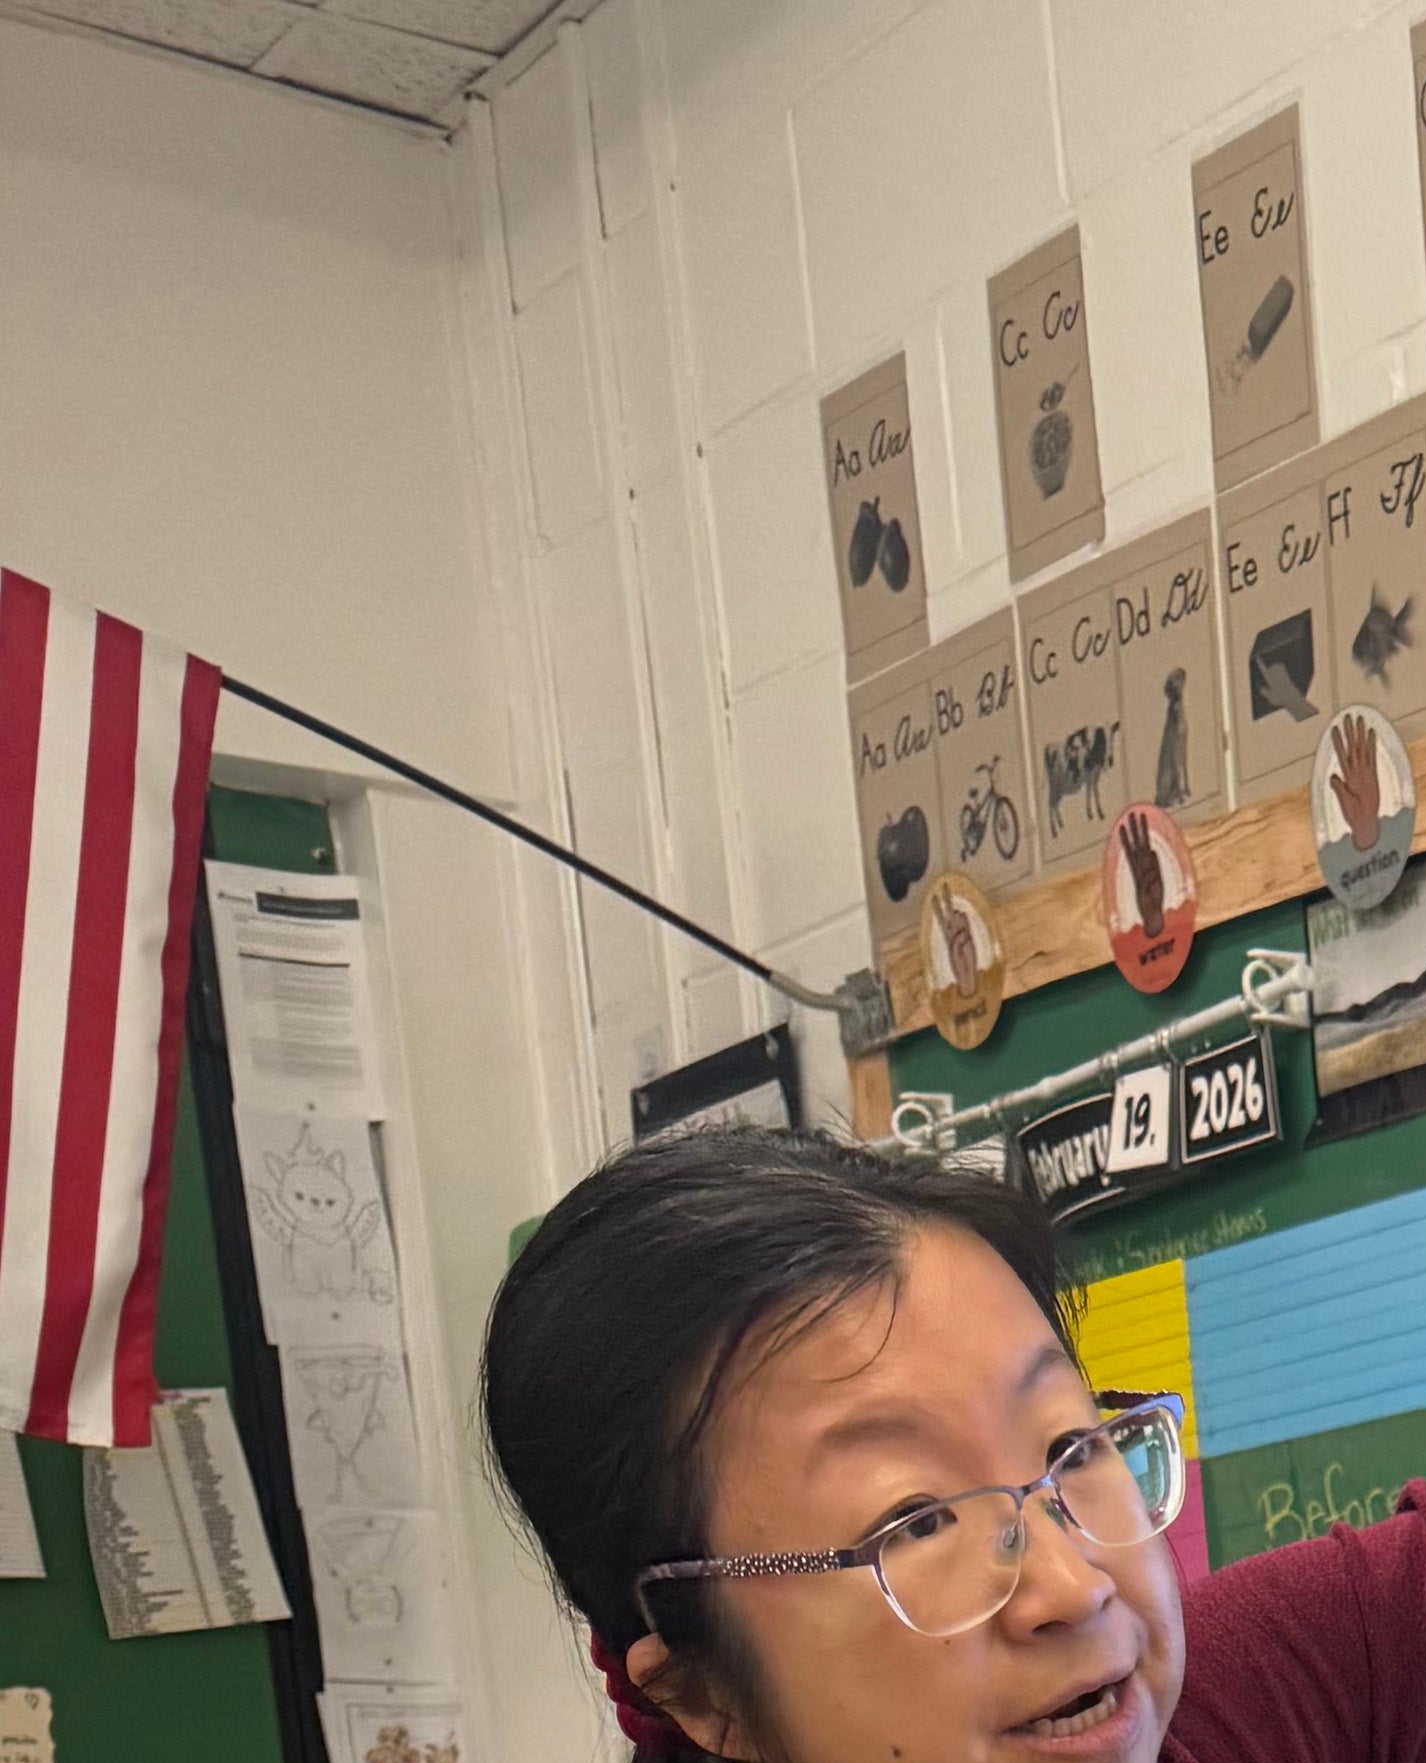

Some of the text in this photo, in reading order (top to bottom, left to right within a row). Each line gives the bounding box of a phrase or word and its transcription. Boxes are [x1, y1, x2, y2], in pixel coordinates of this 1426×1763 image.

[1200, 212, 1230, 264] Ee
[1001, 320, 1030, 367] Cc
[834, 443, 860, 487] Aa
[1228, 545, 1258, 594] Ee
[1117, 596, 1151, 647] Dd
[1030, 639, 1058, 686] Cc
[936, 689, 963, 737] Bb
[860, 733, 887, 778] Aa
[1189, 1057, 1263, 1141] 2026
